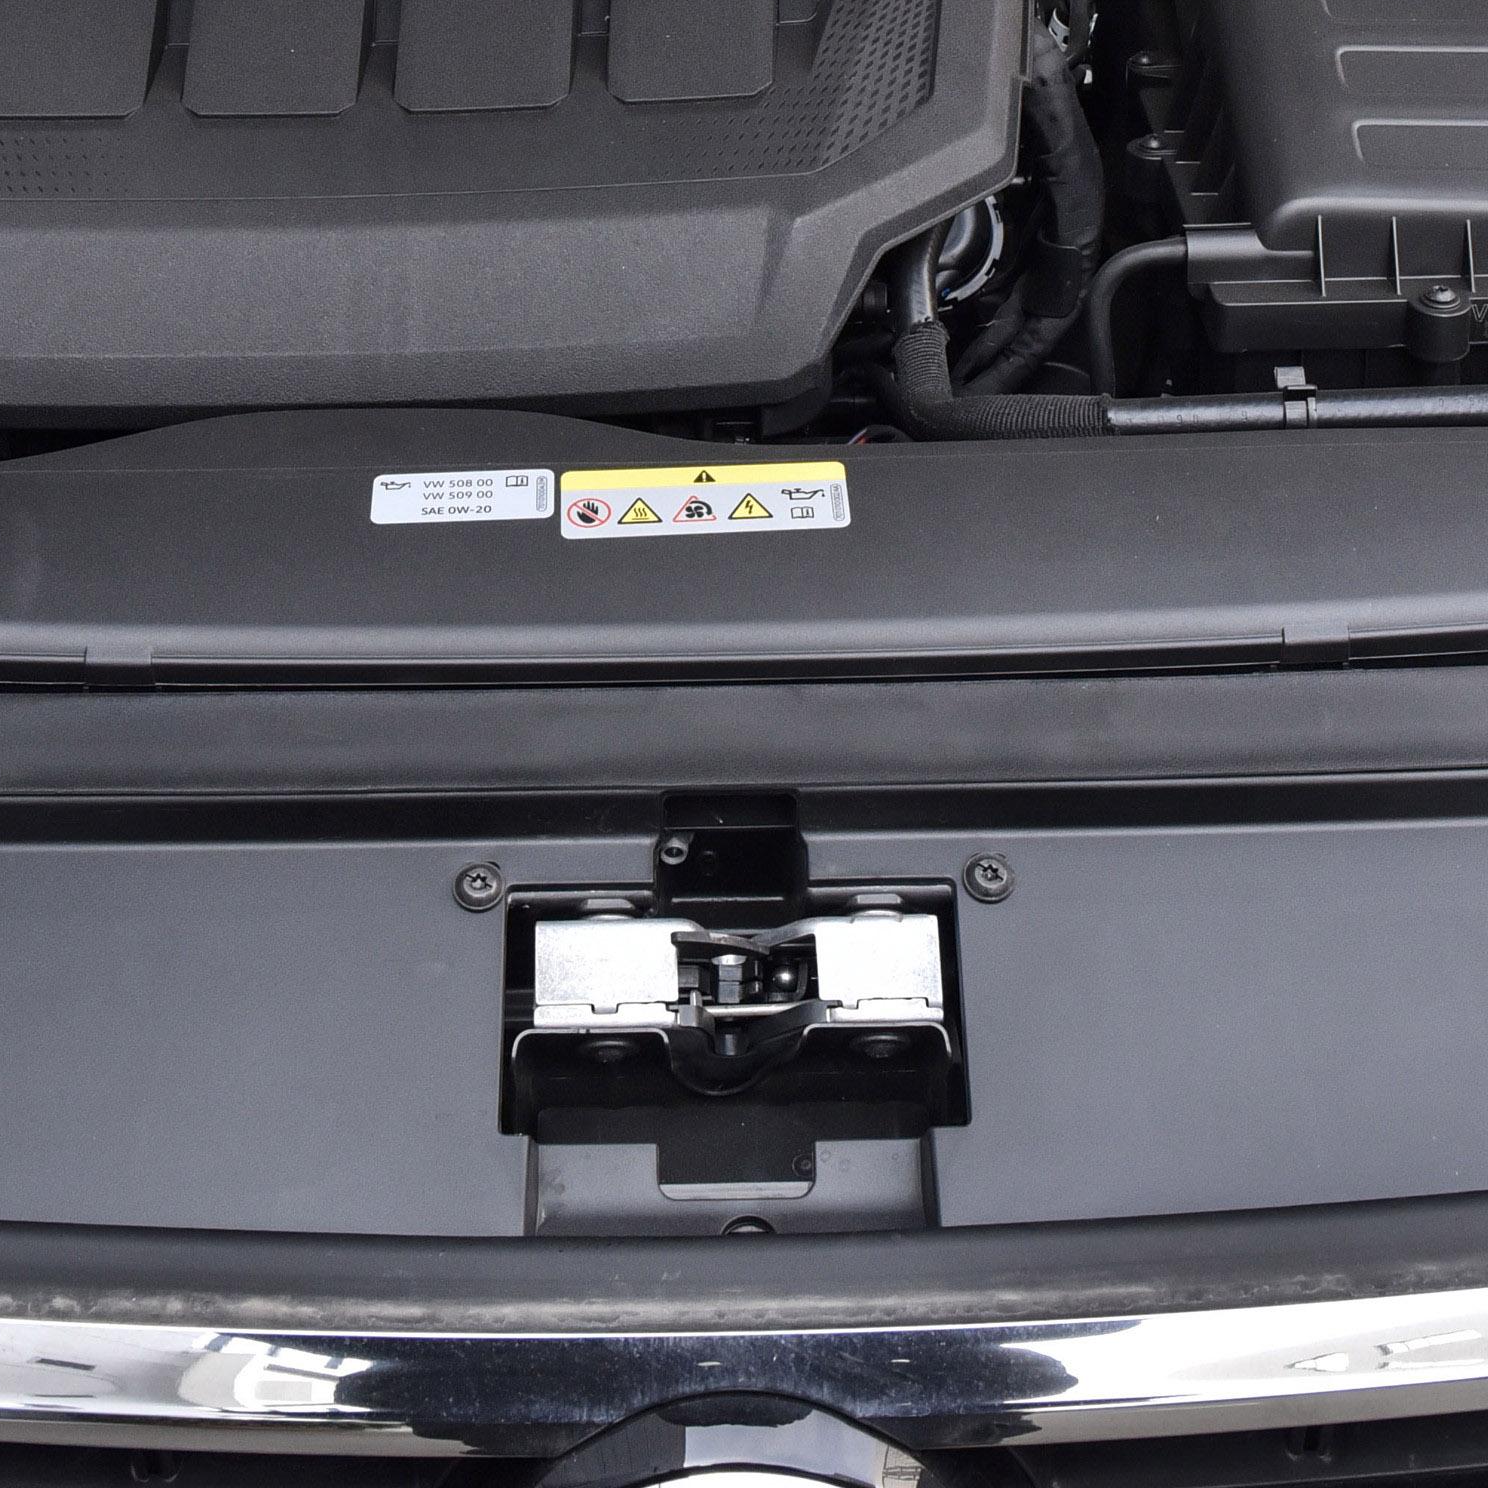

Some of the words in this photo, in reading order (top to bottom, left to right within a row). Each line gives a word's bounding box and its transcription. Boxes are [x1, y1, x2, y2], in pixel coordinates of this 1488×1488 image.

[423, 480, 444, 488] VW
[449, 479, 473, 488] 508
[476, 478, 493, 487] 00
[423, 492, 444, 500] VW
[449, 491, 473, 499] 509
[476, 490, 493, 499] 00
[421, 507, 444, 515] SAE
[447, 505, 492, 515] 0W-20
